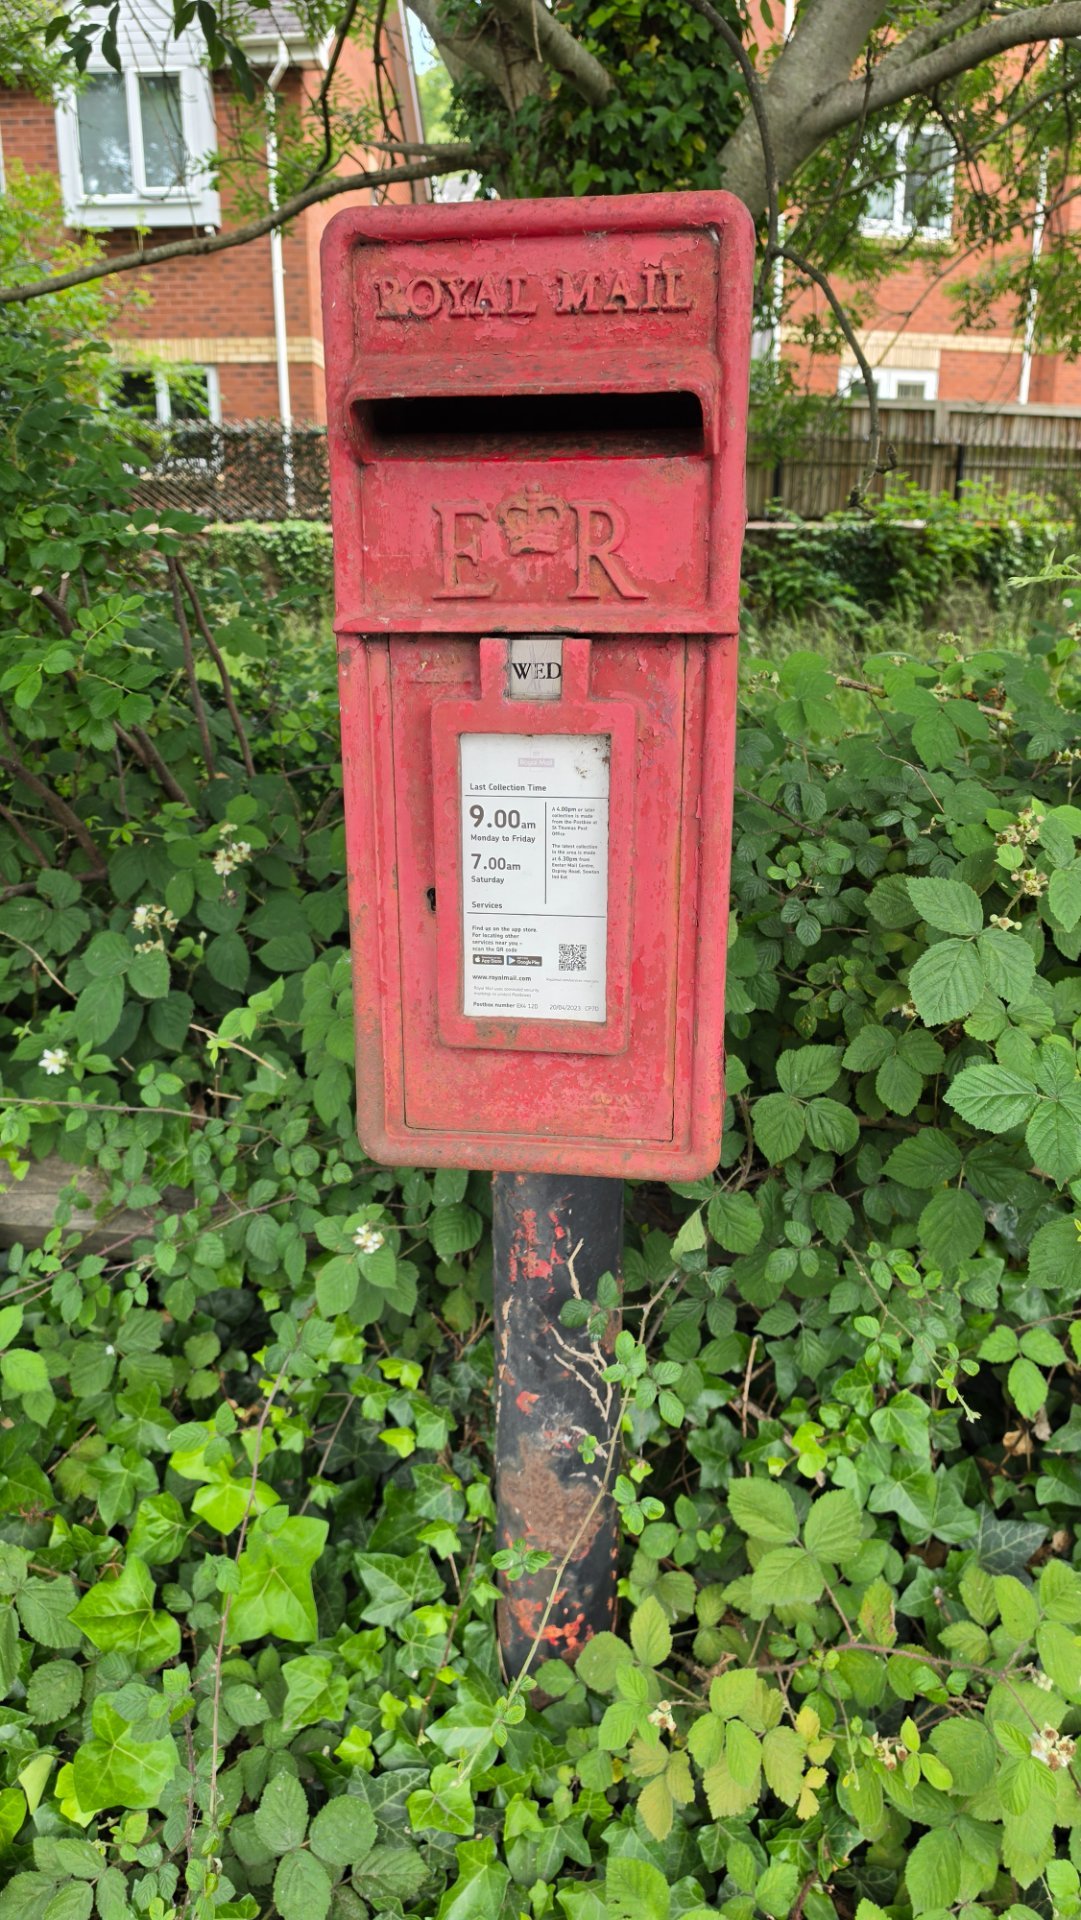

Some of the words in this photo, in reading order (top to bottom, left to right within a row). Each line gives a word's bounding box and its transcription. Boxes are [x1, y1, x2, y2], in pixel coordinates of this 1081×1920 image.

[374, 274, 537, 319] ROYAL
[555, 267, 693, 316] MAIL
[512, 661, 562, 680] WED
[469, 783, 486, 791] Last
[488, 783, 525, 792] Collection
[528, 784, 547, 792] Time
[469, 804, 536, 829] 9.00am
[470, 834, 500, 843] Monday
[502, 834, 510, 842] to
[512, 834, 536, 844] Friday
[470, 853, 521, 871] 7.00am
[471, 875, 505, 885] Saturday
[471, 901, 503, 910] Services
[472, 974, 532, 982] www.royalmail.com
